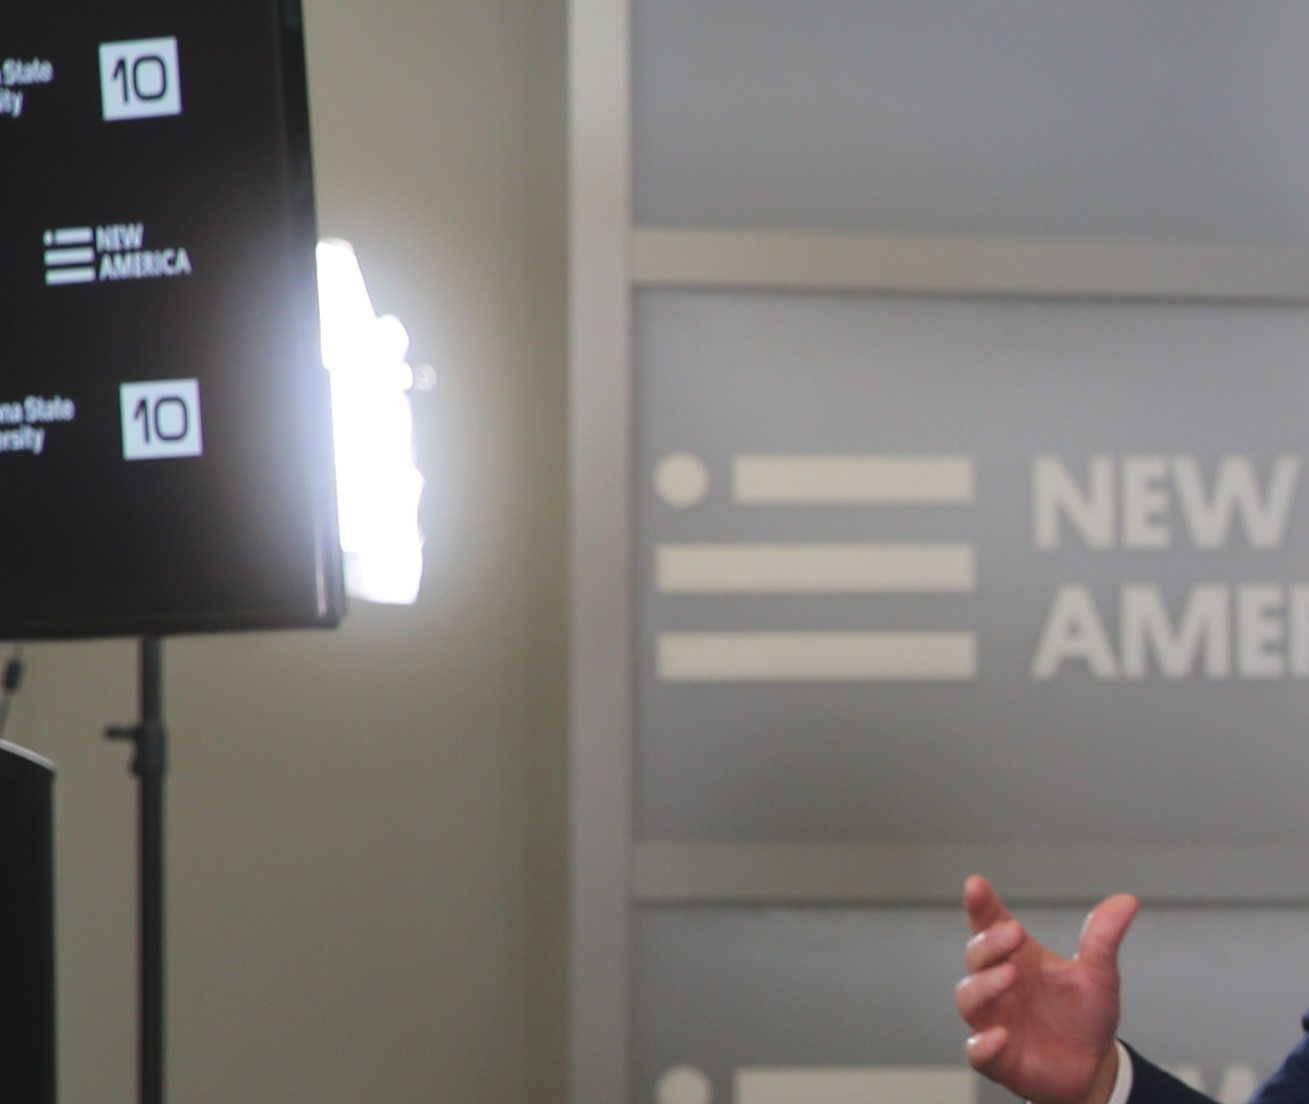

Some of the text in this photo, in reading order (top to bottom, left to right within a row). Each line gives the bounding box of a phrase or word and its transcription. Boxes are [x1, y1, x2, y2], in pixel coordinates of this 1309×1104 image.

[2, 57, 54, 86] State
[111, 54, 168, 106] 10
[96, 222, 144, 252] NEW
[99, 247, 193, 281] AMERICA
[24, 395, 76, 422] State
[133, 396, 189, 443] 10
[1031, 454, 1302, 552] NEW
